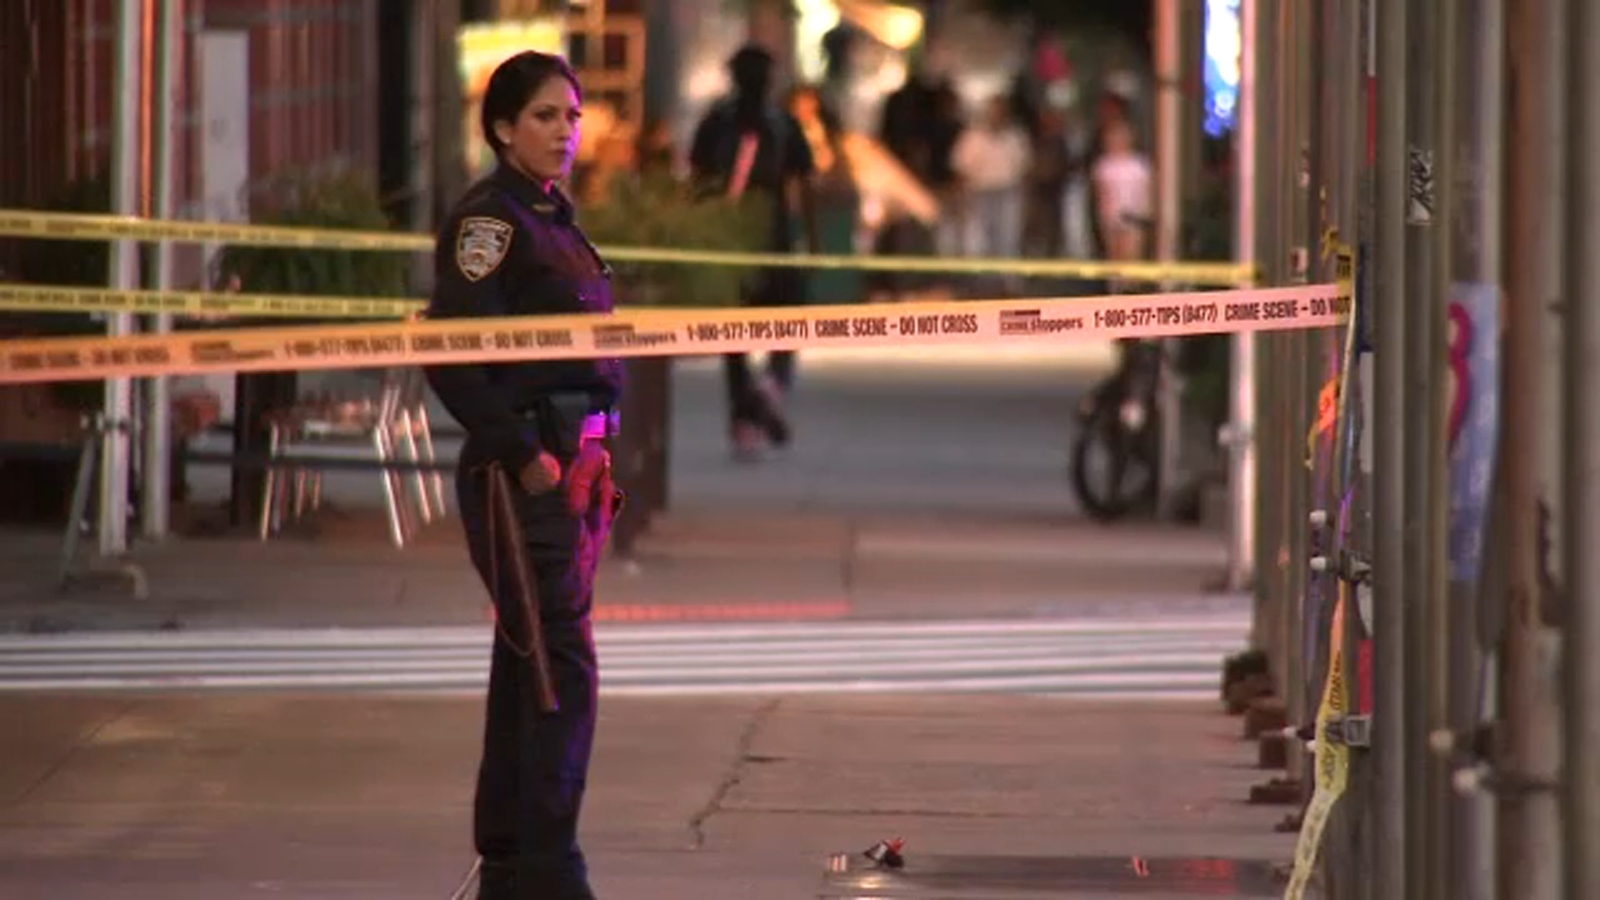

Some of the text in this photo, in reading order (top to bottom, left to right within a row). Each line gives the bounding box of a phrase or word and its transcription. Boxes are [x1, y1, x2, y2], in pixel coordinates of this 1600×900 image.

[1225, 302, 1260, 321] CRIME
[1262, 300, 1298, 319] SCENE
[1311, 298, 1326, 316] DO
[1328, 296, 1350, 315] NOT
[815, 318, 850, 338] CRIME
[852, 317, 887, 336] SCENE
[899, 316, 915, 335] DO
[917, 315, 939, 334] NOT
[941, 314, 978, 334] CROSS
[1030, 316, 1083, 333] stoppers
